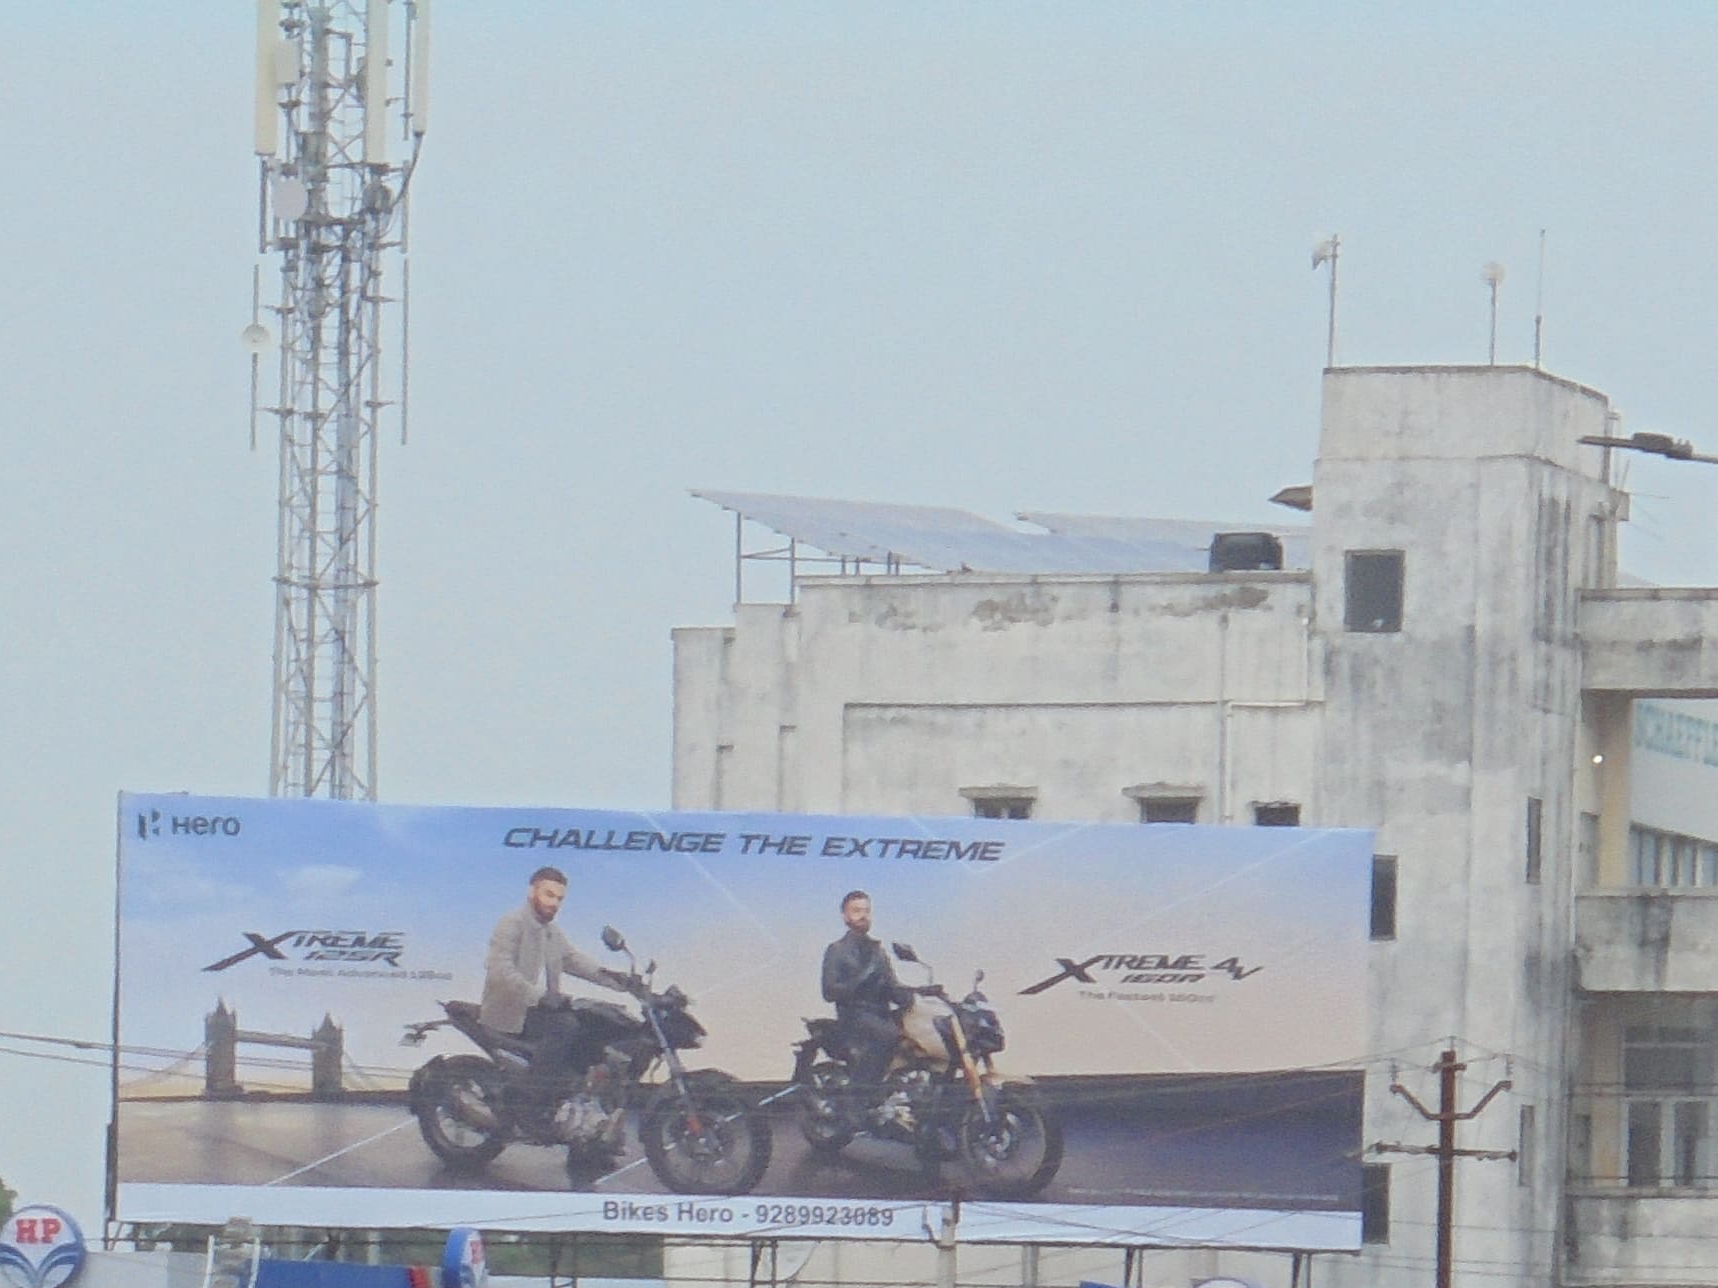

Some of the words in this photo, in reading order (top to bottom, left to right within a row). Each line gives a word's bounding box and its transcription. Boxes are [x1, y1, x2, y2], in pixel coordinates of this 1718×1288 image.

[171, 815, 241, 836] Hero
[504, 827, 726, 854] CHALLENGE
[739, 833, 812, 857] THE
[819, 836, 1006, 862] EXTREME
[200, 930, 405, 972] XTREME
[1017, 954, 1206, 995] XTREME
[603, 1202, 668, 1222] Bikes
[678, 1203, 733, 1223] Hero
[756, 1204, 894, 1226] 9289923089
[16, 1218, 62, 1243] HP
